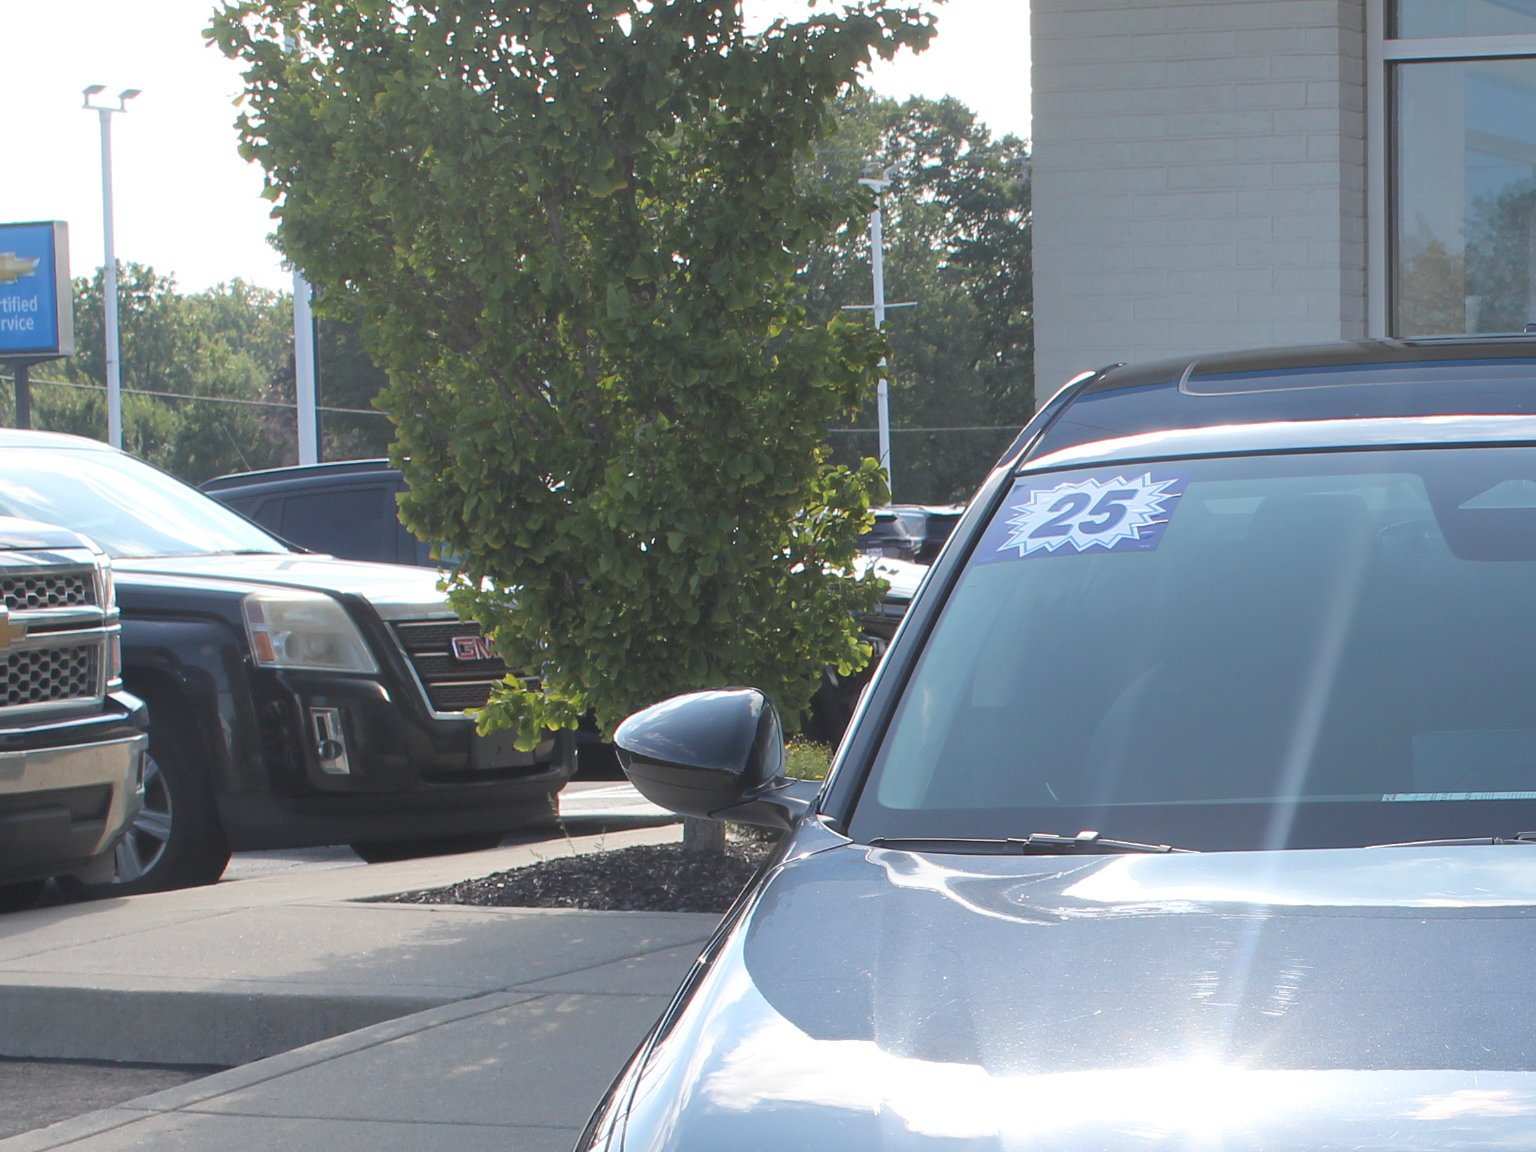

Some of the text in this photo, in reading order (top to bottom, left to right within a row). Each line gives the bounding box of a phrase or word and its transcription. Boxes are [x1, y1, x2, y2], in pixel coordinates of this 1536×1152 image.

[0, 295, 38, 313] tified
[1028, 489, 1139, 539] 25
[452, 636, 503, 660] GM
